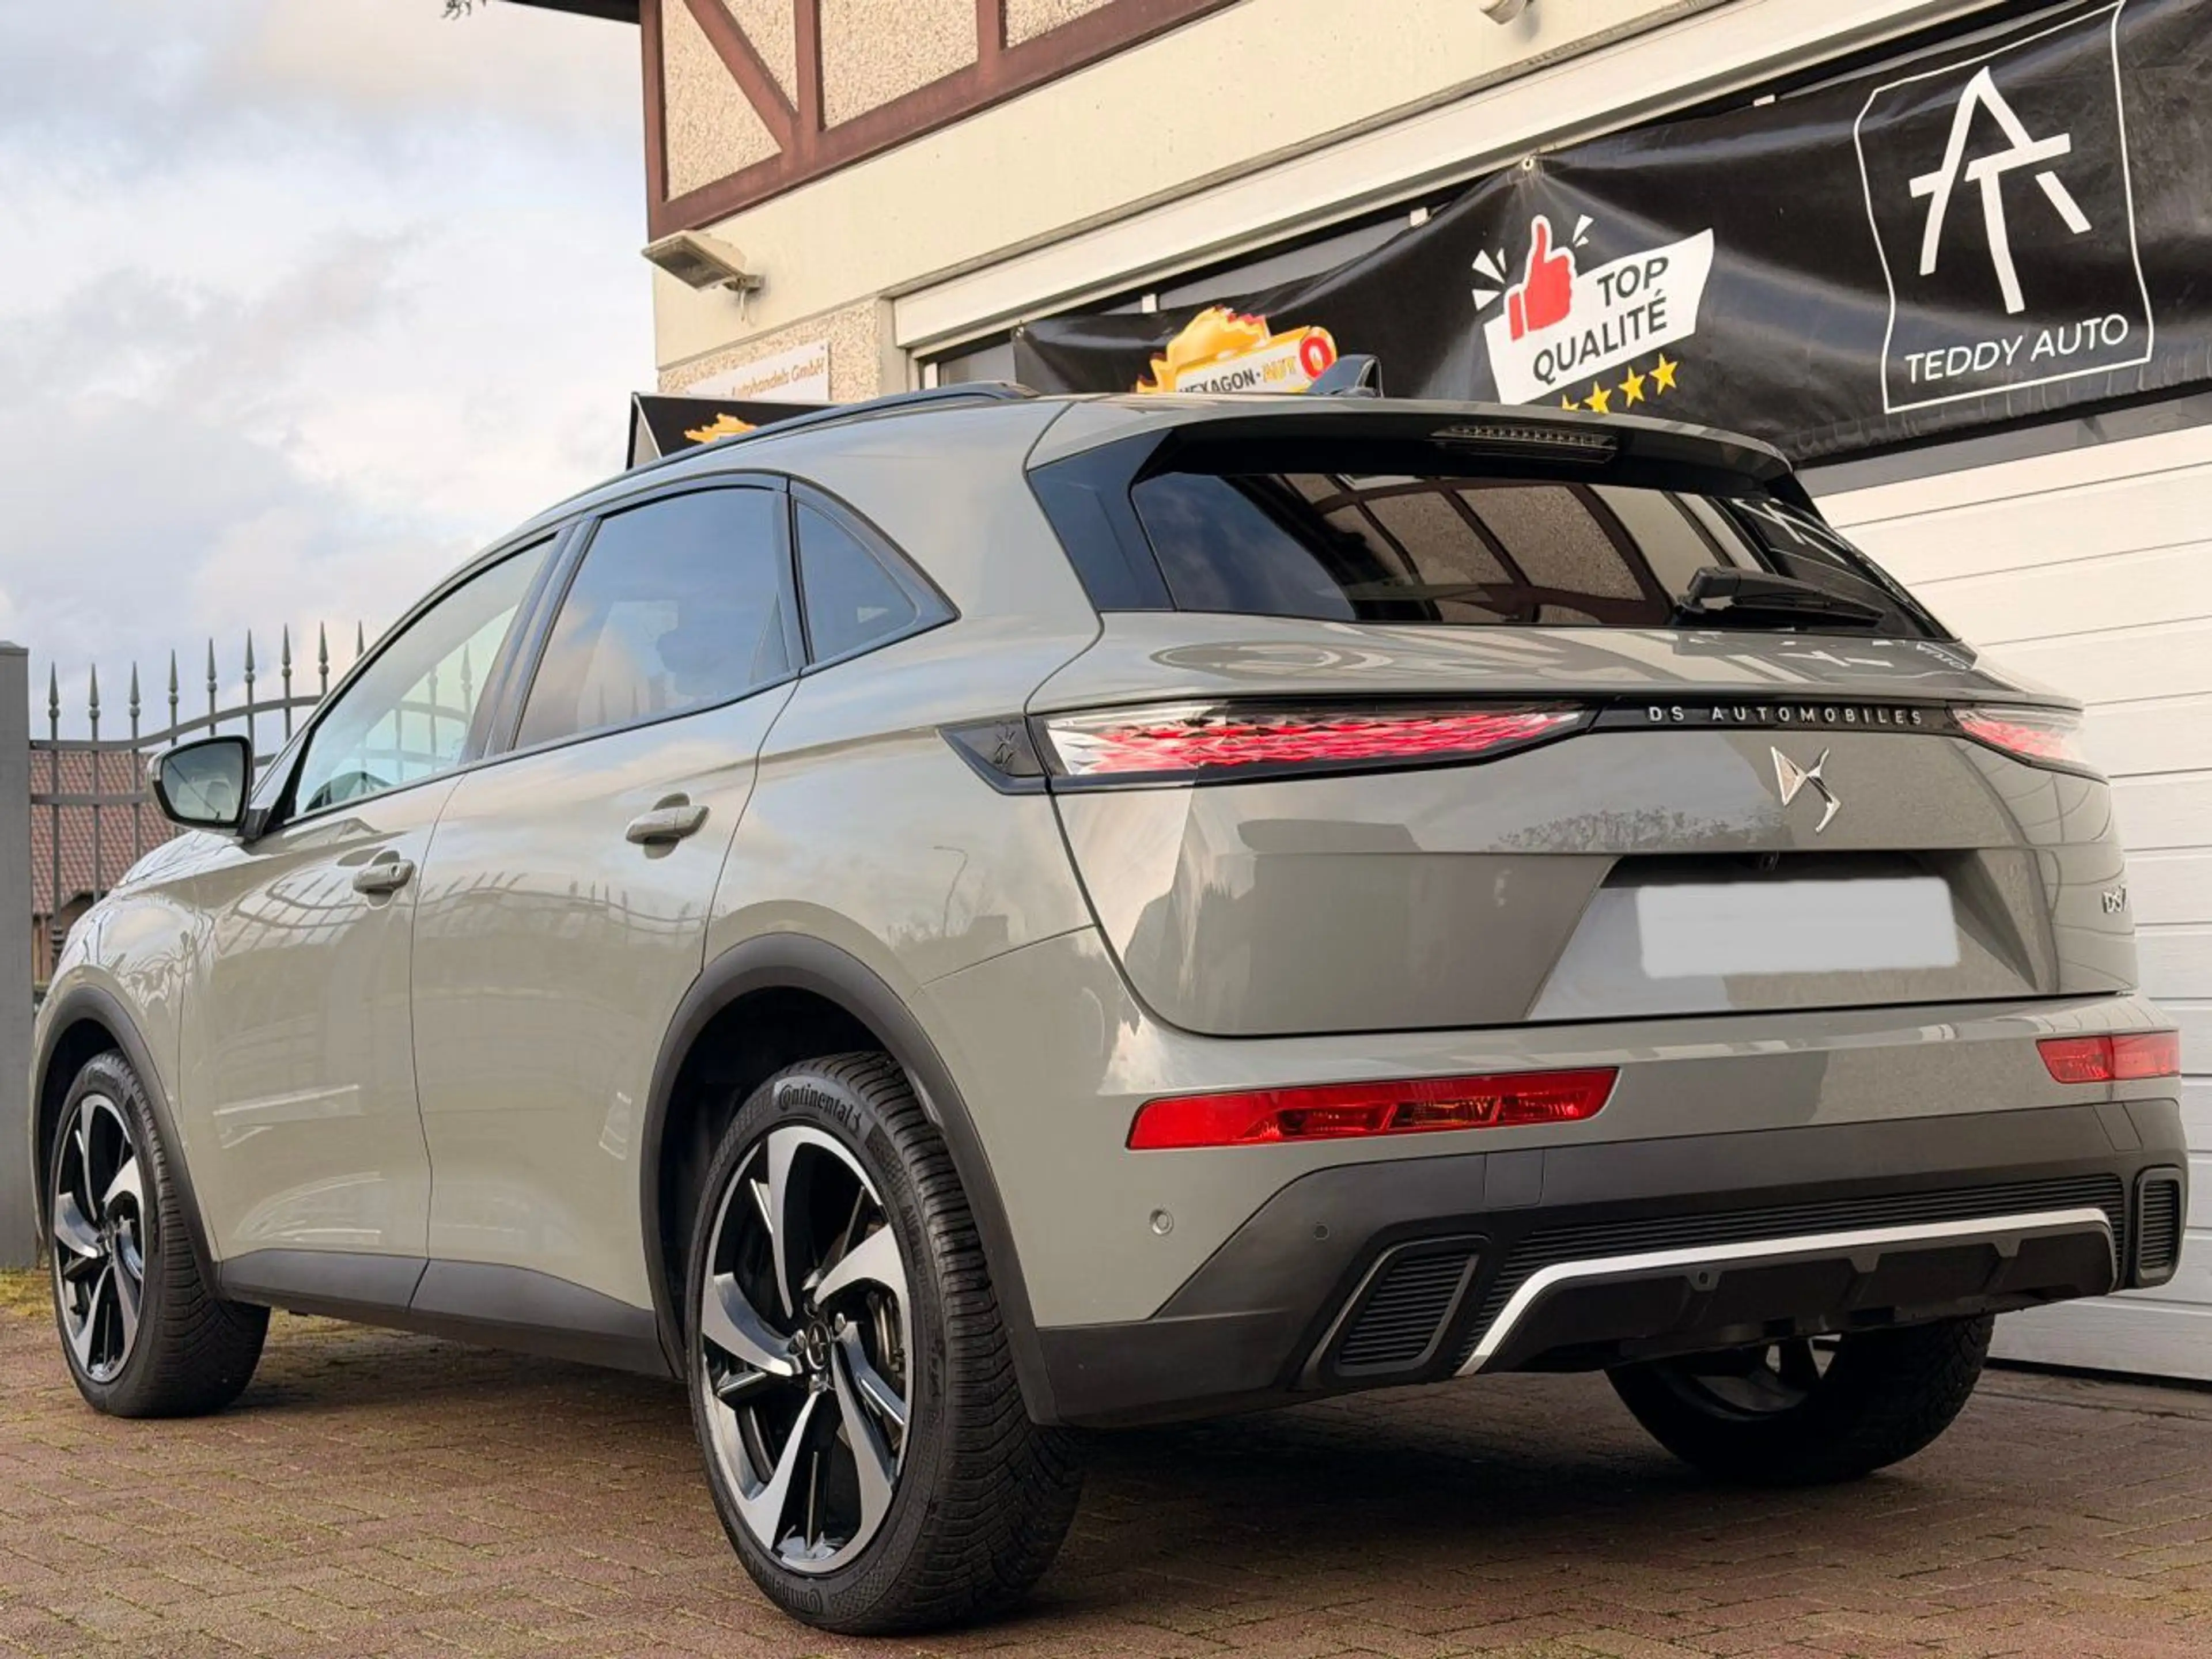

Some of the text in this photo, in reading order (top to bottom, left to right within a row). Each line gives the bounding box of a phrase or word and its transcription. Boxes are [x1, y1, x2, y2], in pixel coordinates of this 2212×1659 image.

[1597, 257, 1669, 307] TOP
[1533, 289, 1668, 385] QUALITÉ
[1904, 313, 2128, 384] TEDDY AUTO
[1179, 368, 1256, 393] XAGON
[1649, 706, 1922, 725] DS AUTOMOBILES
[779, 1083, 854, 1128] Continental
